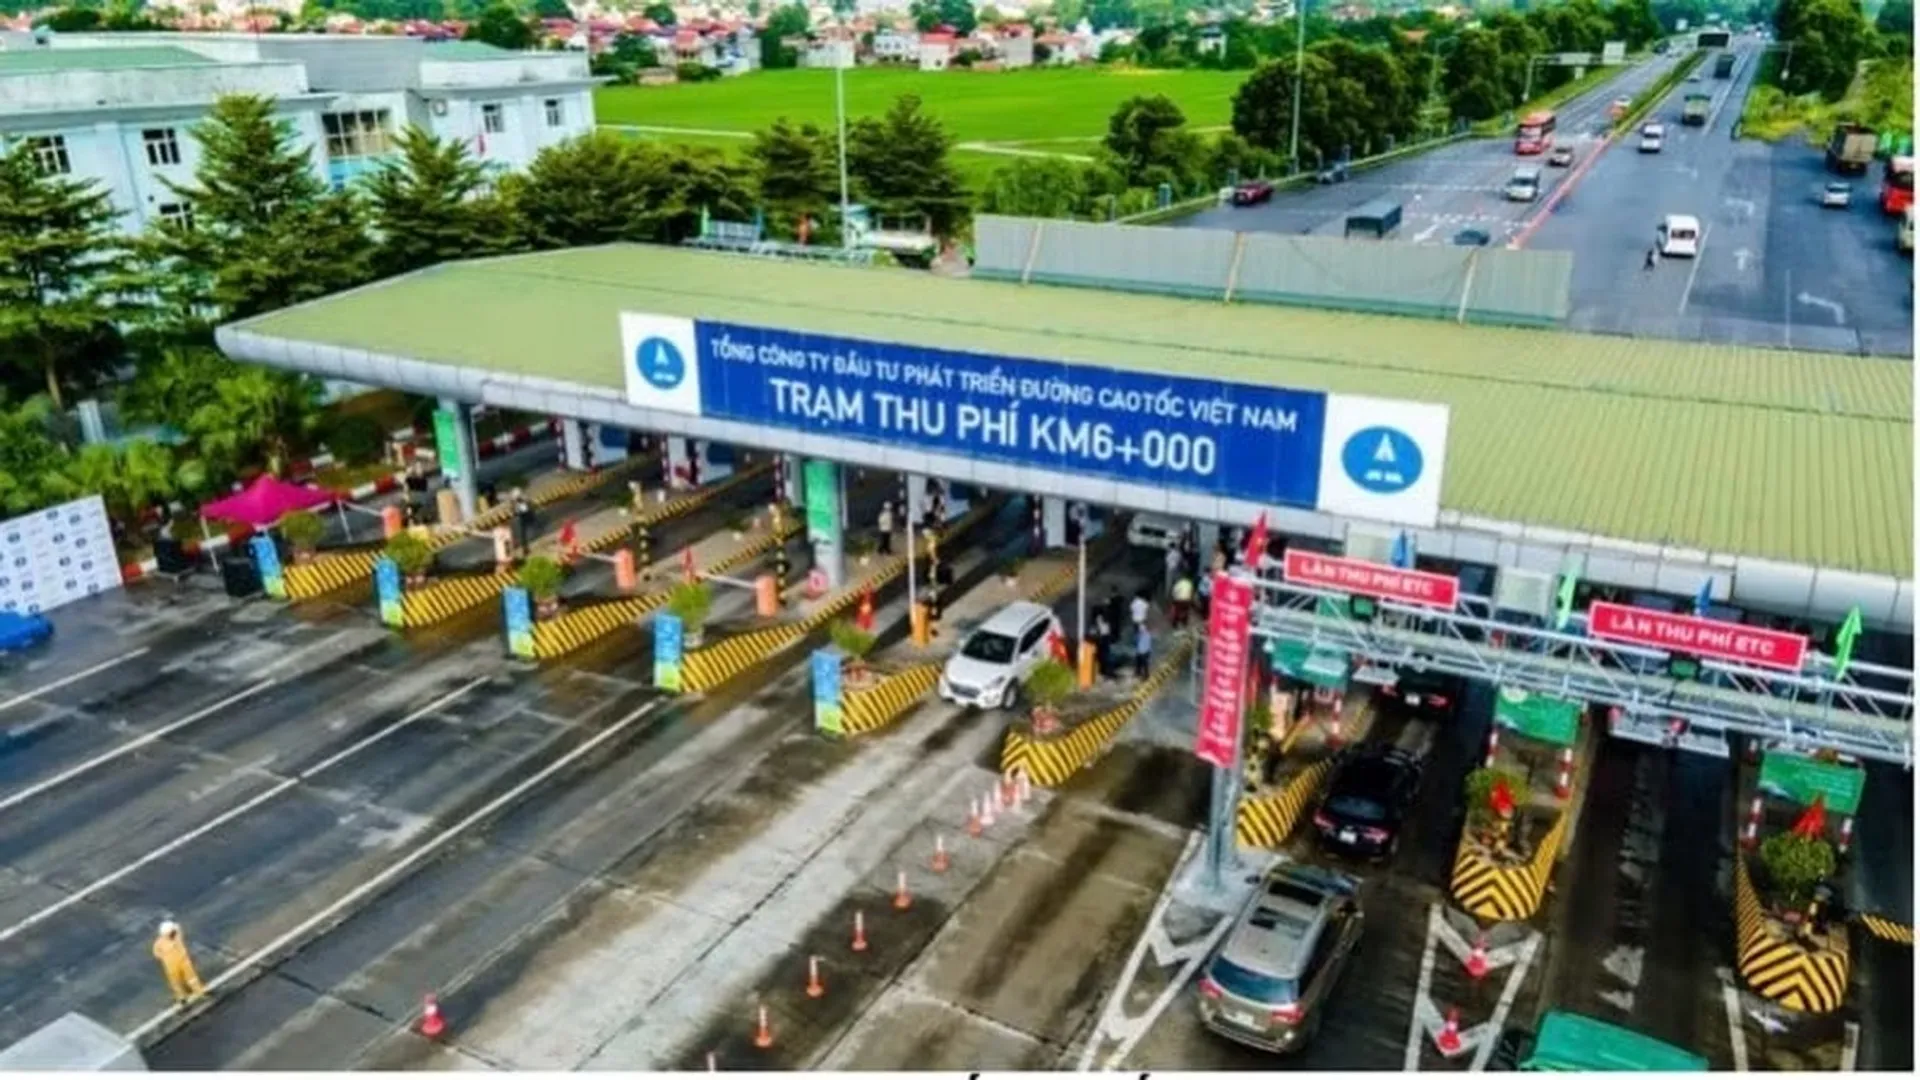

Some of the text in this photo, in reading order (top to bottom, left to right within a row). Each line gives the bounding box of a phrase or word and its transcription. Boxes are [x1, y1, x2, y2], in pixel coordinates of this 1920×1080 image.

[758, 342, 806, 370] CÔNG
[807, 351, 830, 373] TY
[903, 361, 954, 388] PHÁT
[1188, 398, 1238, 427] VIỆT
[1241, 406, 1298, 433] NAM
[768, 376, 1216, 476] TRẠM THU PHÍ KM6+000
[1338, 566, 1371, 587] THU
[1402, 576, 1434, 597] ETC
[1609, 611, 1776, 657] LÀN THU PHÍ ETC
